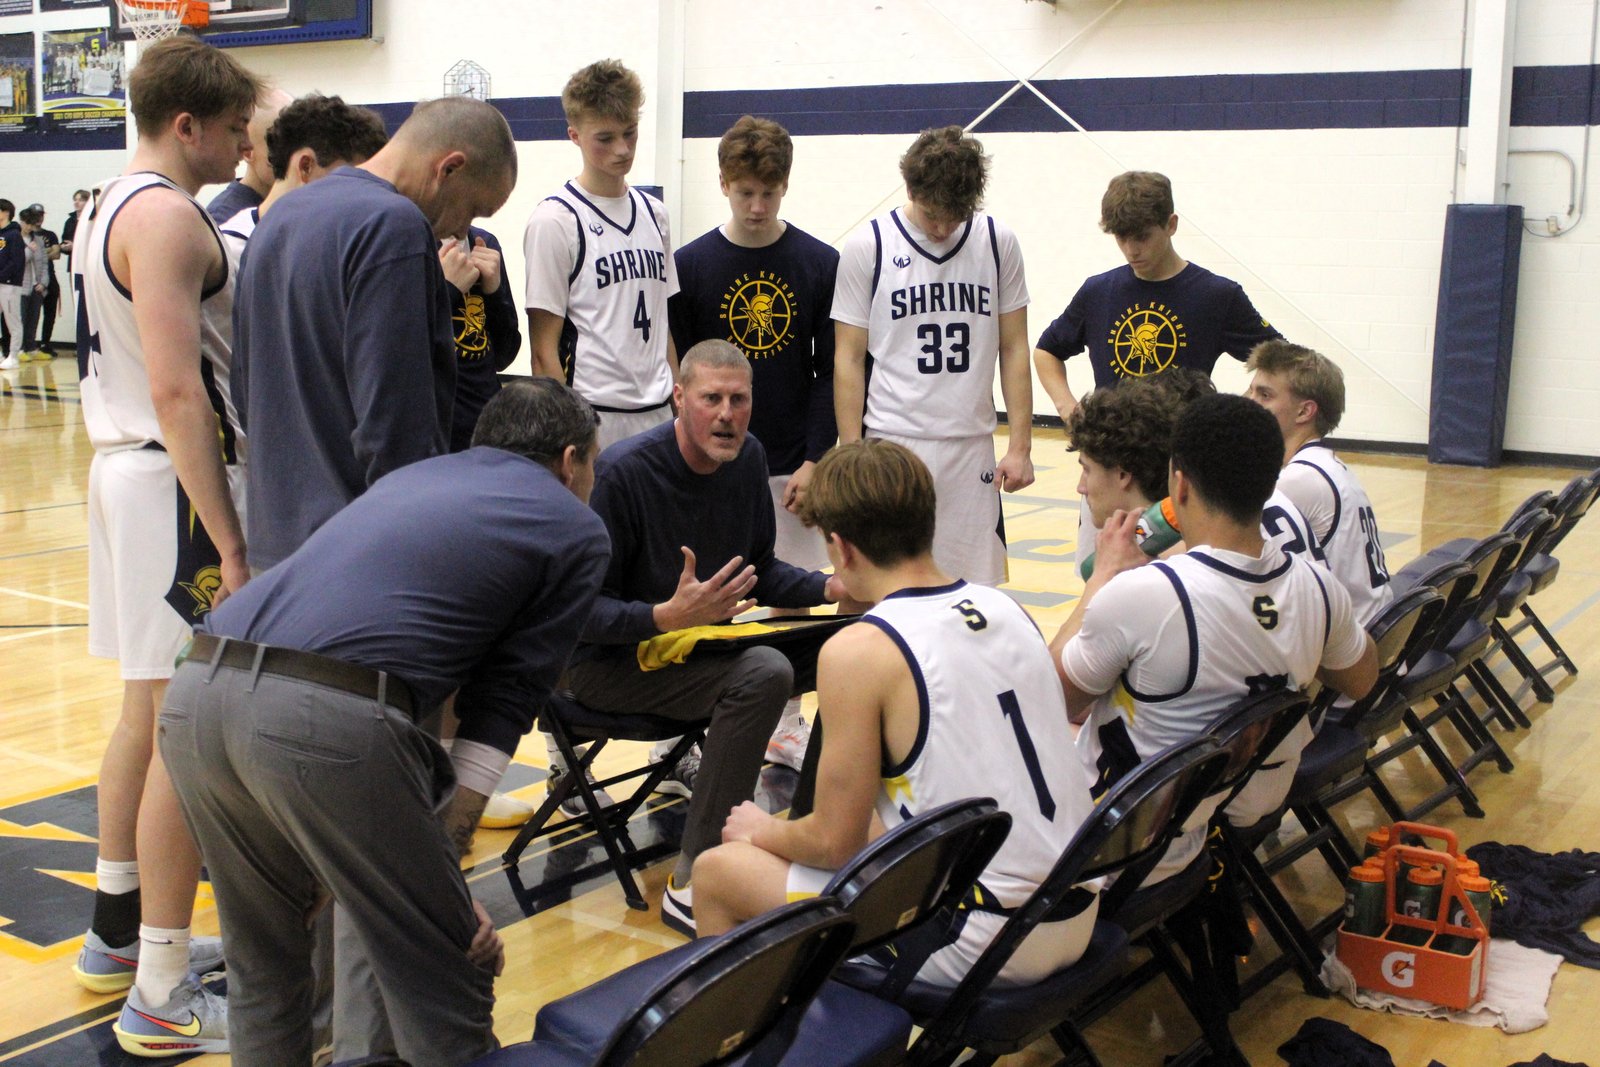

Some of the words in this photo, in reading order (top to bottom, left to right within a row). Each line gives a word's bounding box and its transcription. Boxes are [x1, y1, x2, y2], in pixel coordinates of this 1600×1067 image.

[595, 248, 667, 290] SHRINE
[633, 290, 651, 344] 4
[719, 273, 750, 319] SHRINE
[759, 270, 798, 316] KNIGHTS
[891, 282, 991, 321] SHRINE
[1107, 303, 1140, 344] SHRINE
[1149, 301, 1187, 347] KNIGHTS
[917, 322, 970, 374] 33
[1358, 506, 1390, 589] 20
[951, 598, 988, 632] S
[1252, 594, 1279, 631] S
[996, 689, 1057, 823] 1
[1381, 951, 1416, 988] G
